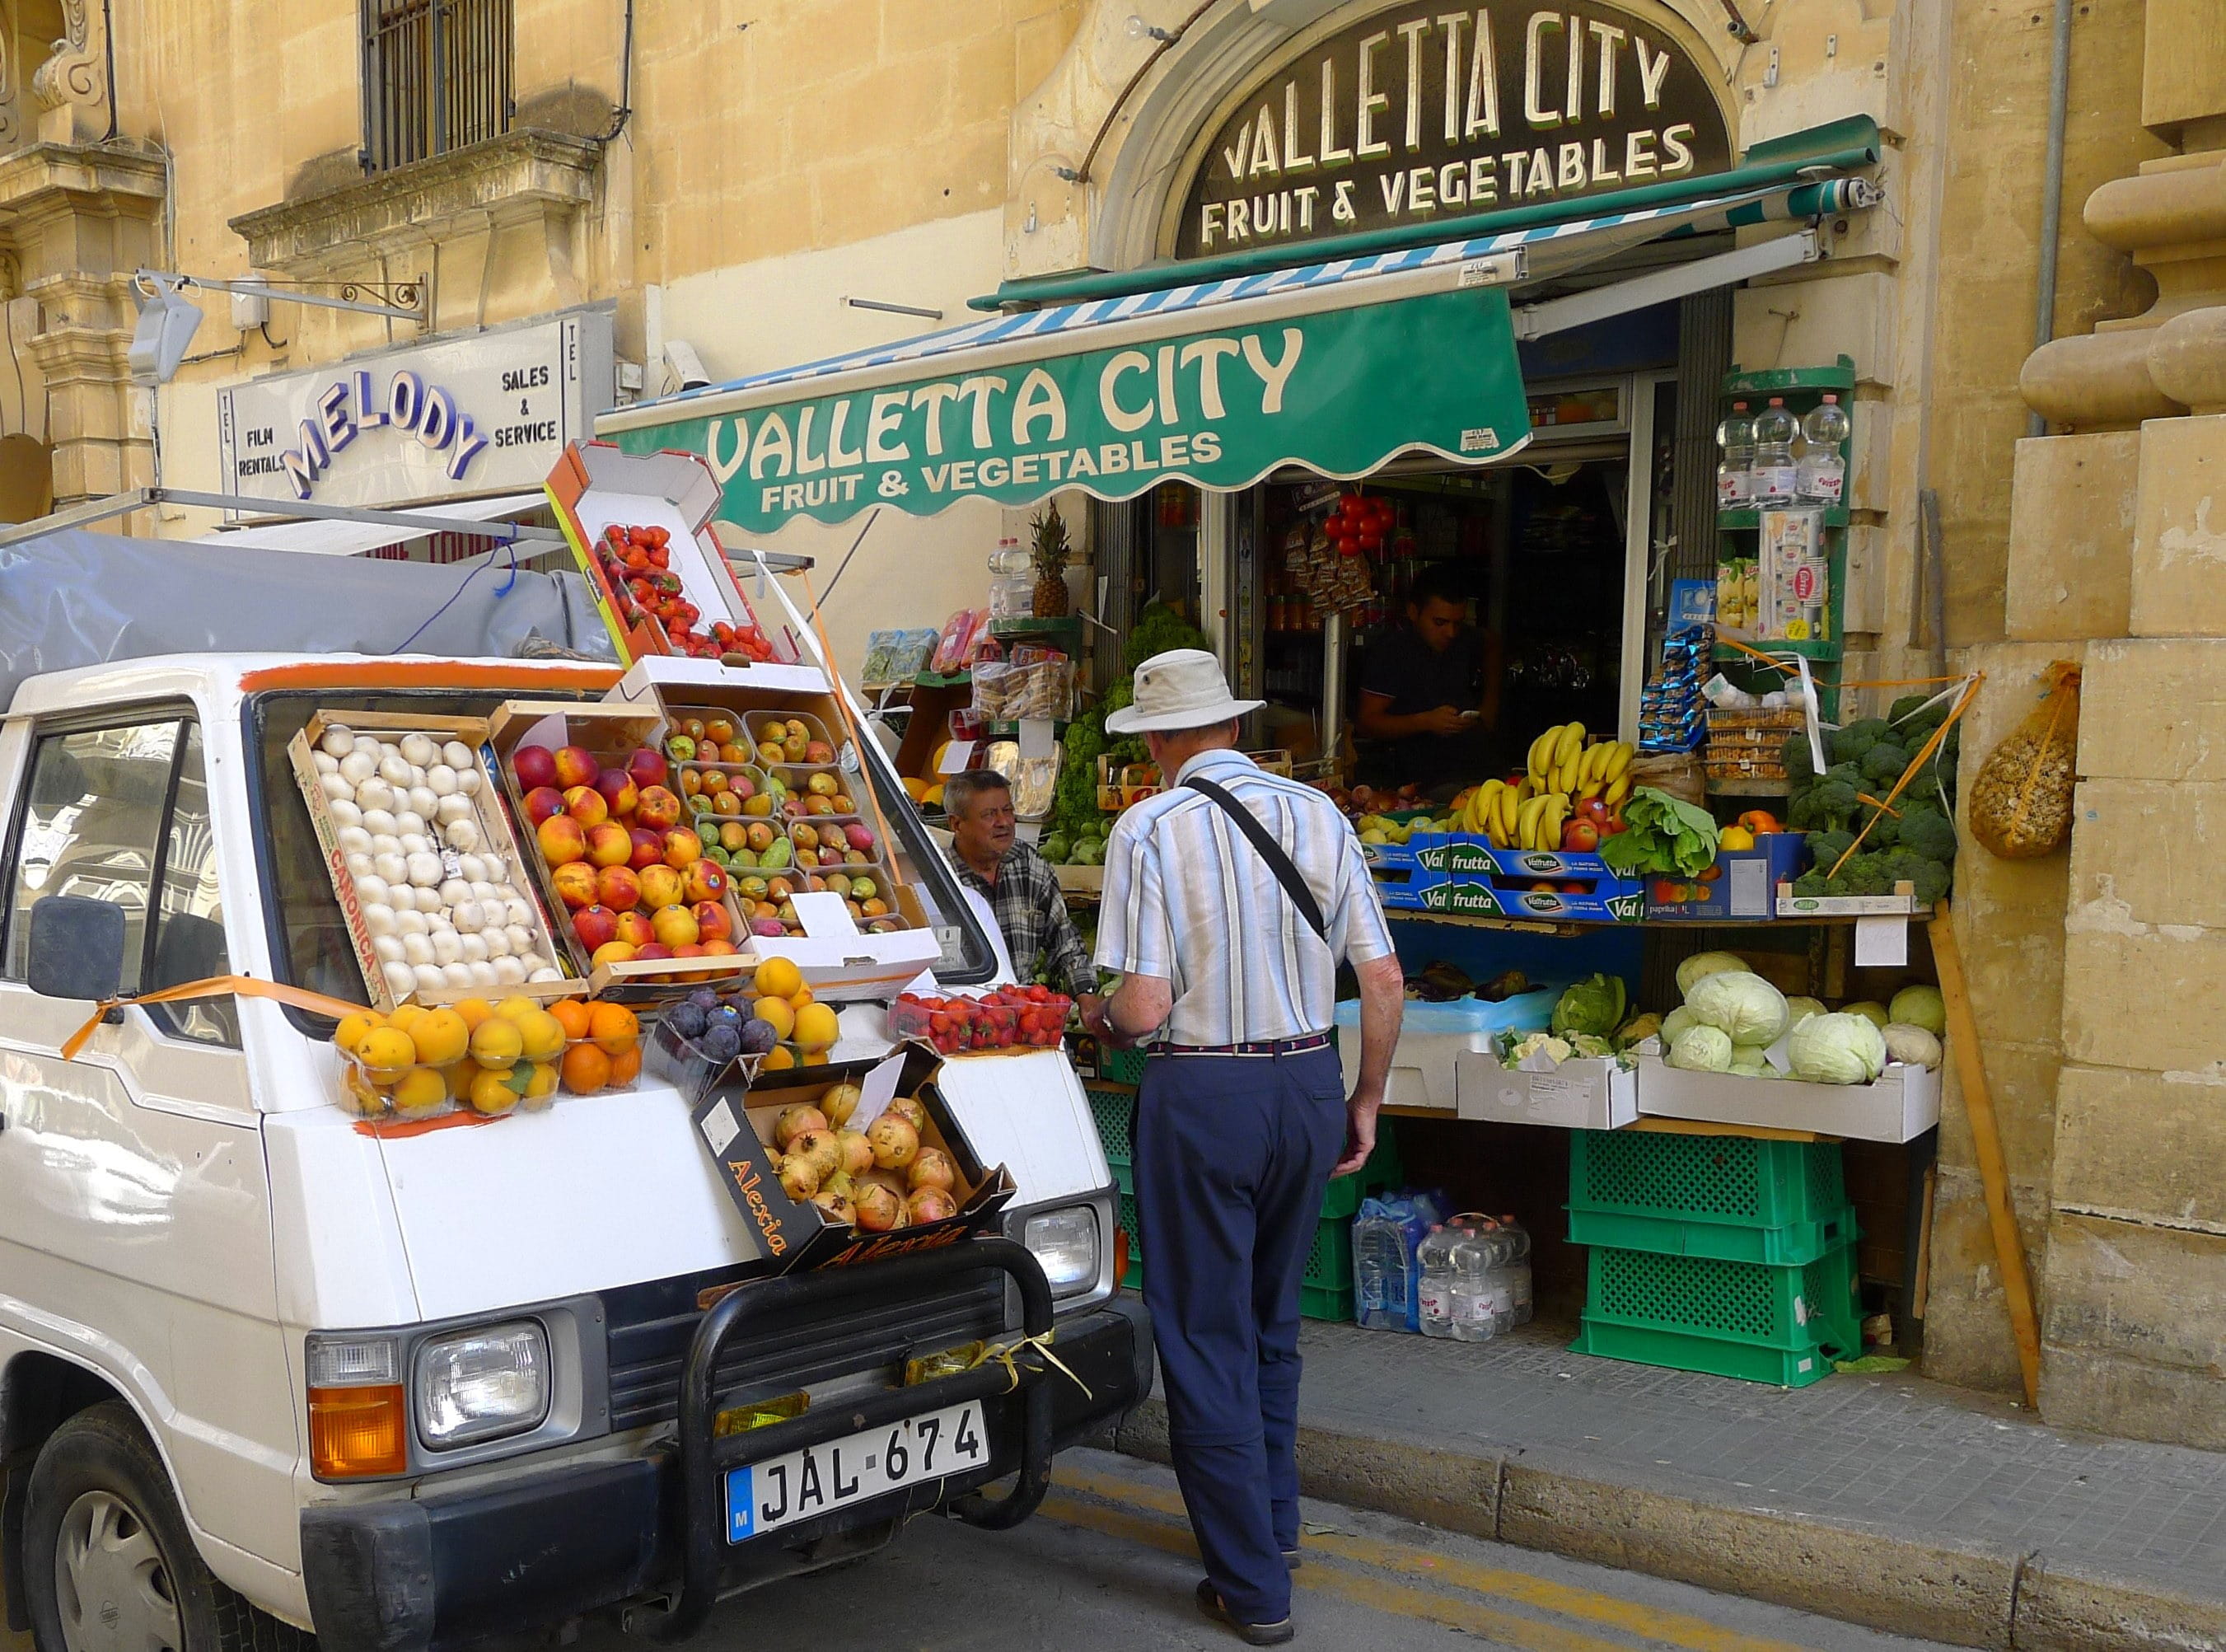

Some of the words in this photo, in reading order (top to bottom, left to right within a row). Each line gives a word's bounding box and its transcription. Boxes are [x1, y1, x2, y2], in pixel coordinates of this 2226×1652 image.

[1224, 8, 1500, 183] VALLETTA
[1524, 12, 1670, 130] CITY
[1201, 185, 1319, 246] FRUIT
[1331, 180, 1356, 222] &
[1380, 123, 1695, 217] VEGETABLES
[502, 365, 549, 391] SALES
[222, 395, 231, 443] TEL
[520, 397, 530, 416] &
[707, 367, 1068, 484] VALLETTA
[1100, 328, 1304, 433] CITY
[246, 427, 274, 447] FILM
[280, 369, 489, 500] MELODY
[494, 420, 557, 448] SERVICE
[761, 473, 864, 513] FRUIT
[877, 470, 910, 498] &
[920, 431, 1223, 494] VEGETABLES
[1424, 851, 1444, 868] Val
[1452, 854, 1491, 870] frutta
[331, 849, 376, 973] CANONICA
[1427, 890, 1447, 907] Val
[1453, 892, 1492, 909] frutta
[1615, 899, 1637, 917] Val
[727, 1159, 788, 1257] Alexia
[735, 1509, 747, 1528] M
